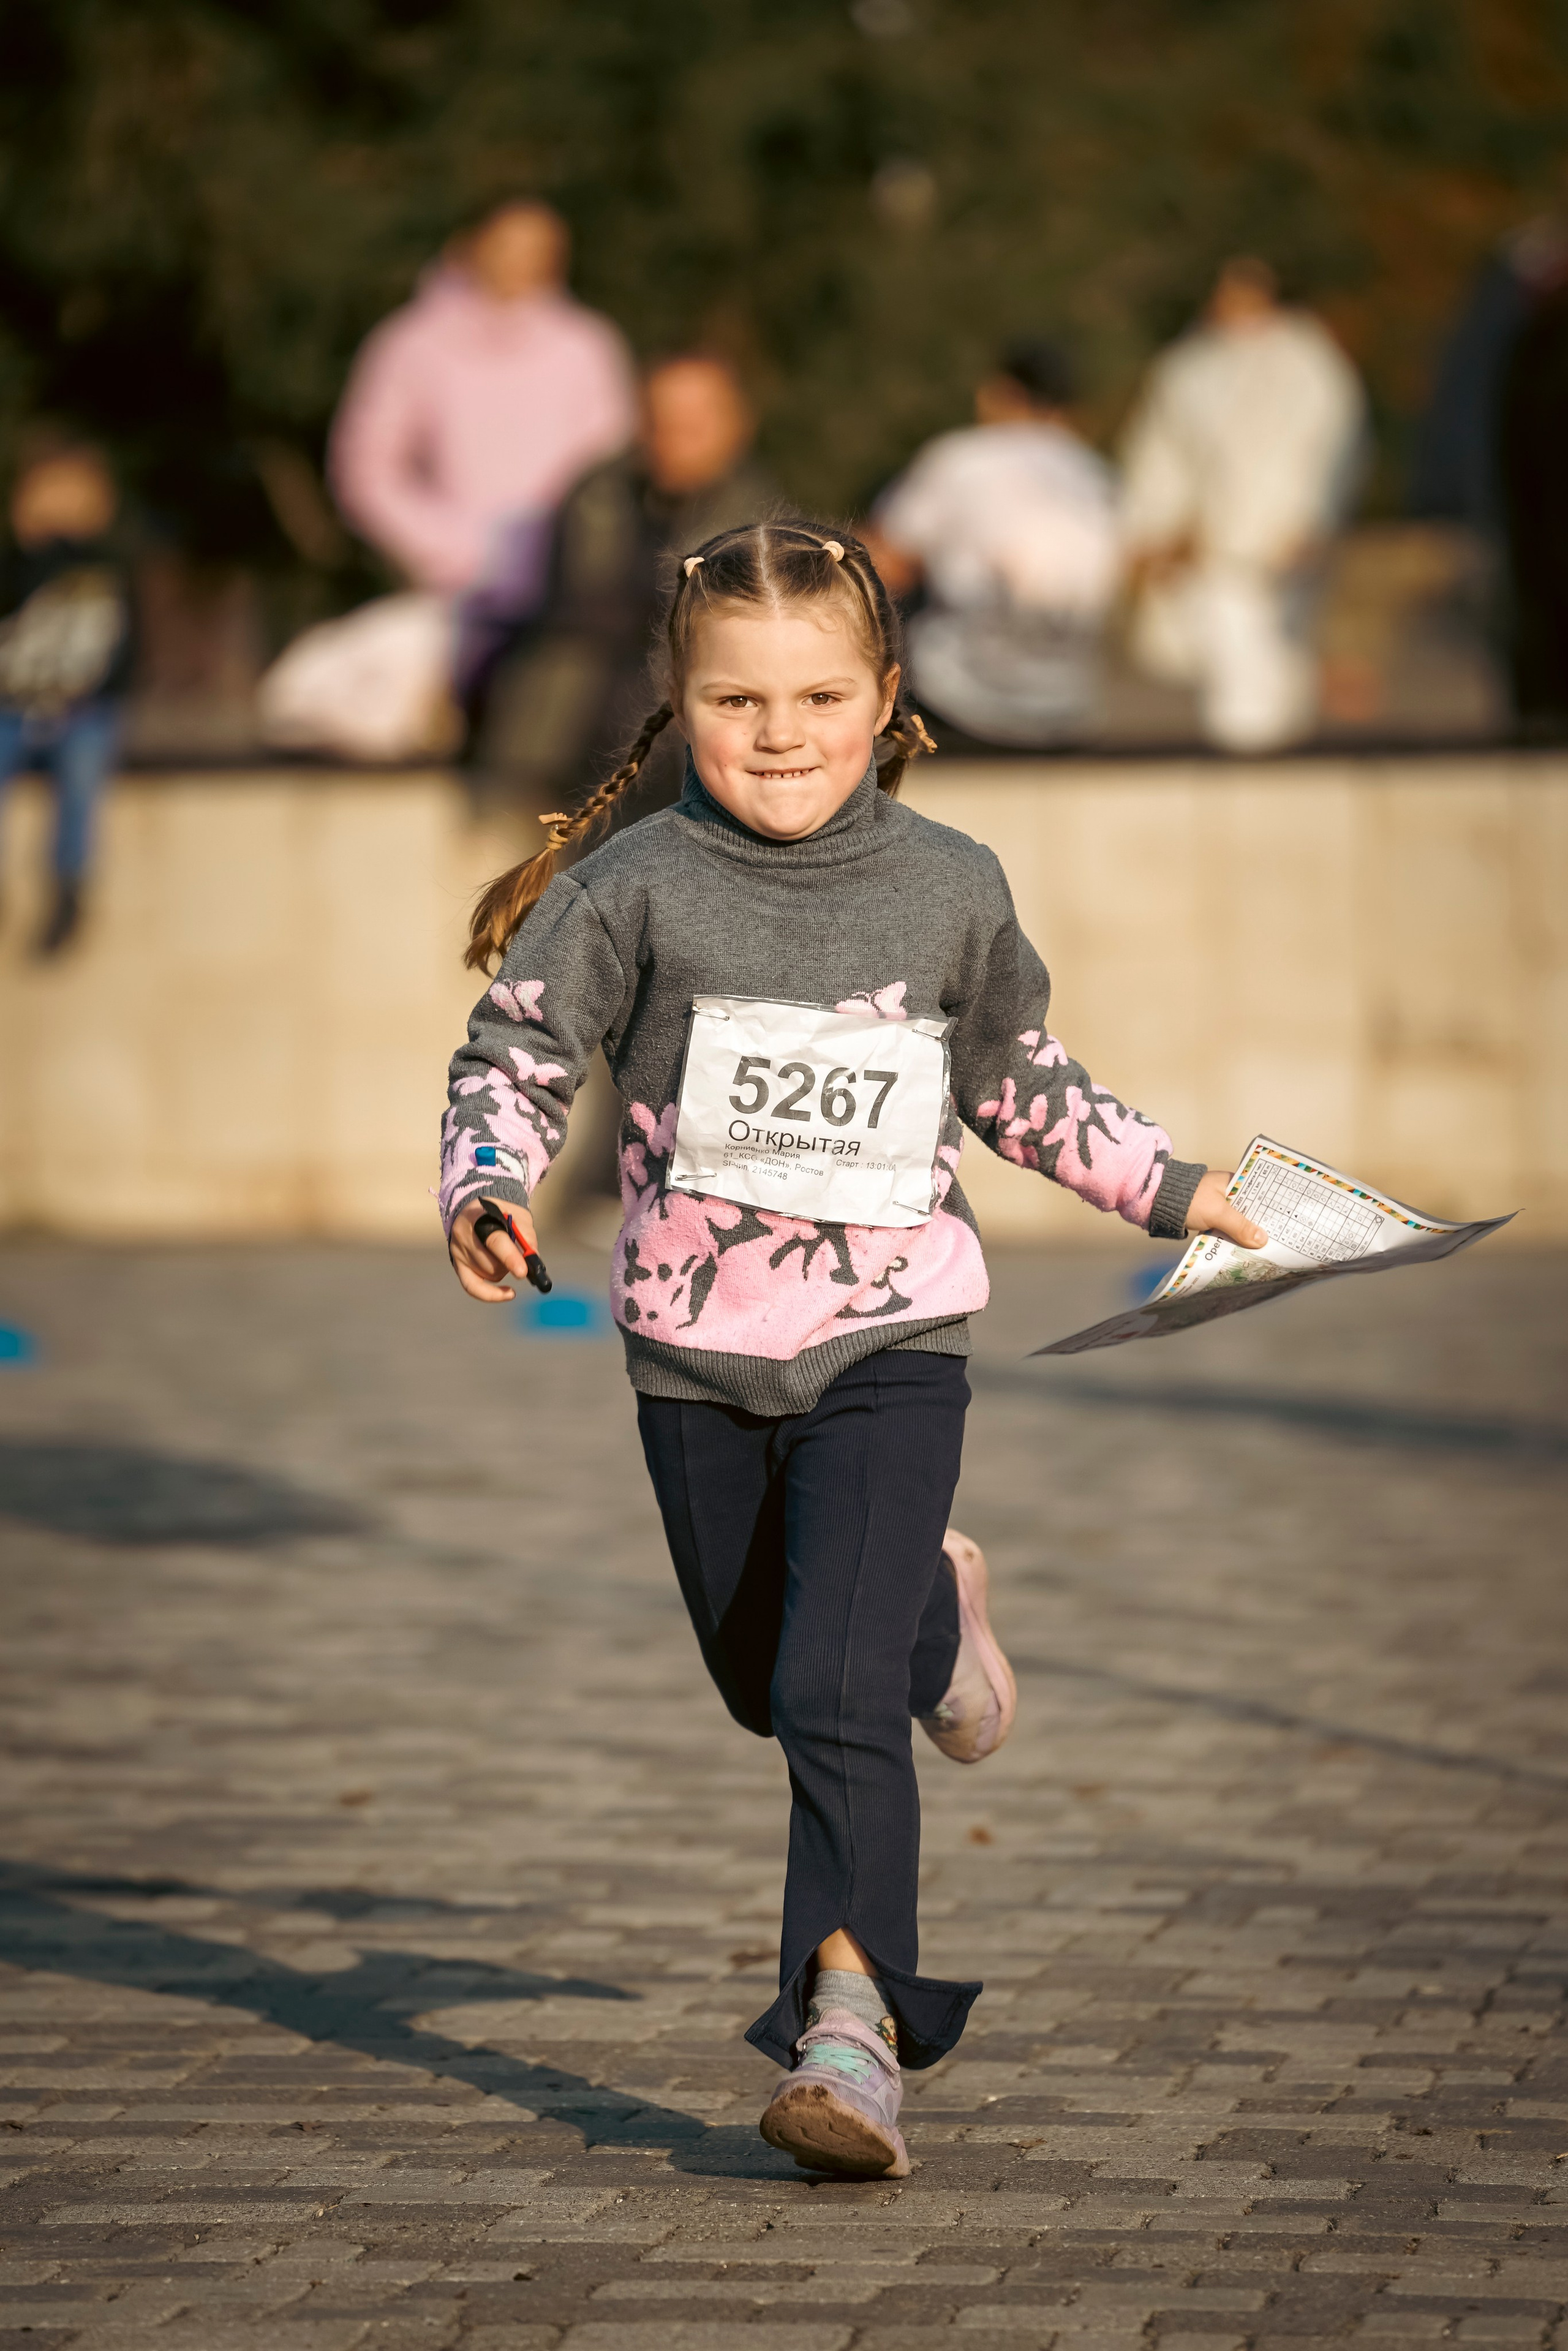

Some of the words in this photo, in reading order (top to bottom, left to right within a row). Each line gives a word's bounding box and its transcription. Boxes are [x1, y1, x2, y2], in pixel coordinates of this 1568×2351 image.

[729, 1055, 899, 1129] 5267
[728, 1120, 861, 1157] Открытая
[725, 1144, 770, 1154] Корниенко
[772, 1149, 801, 1160] Мария
[795, 1163, 824, 1177] Ростов
[836, 1159, 859, 1169] Старт
[752, 1165, 788, 1180] 2145748
[1205, 1236, 1224, 1261] Open
